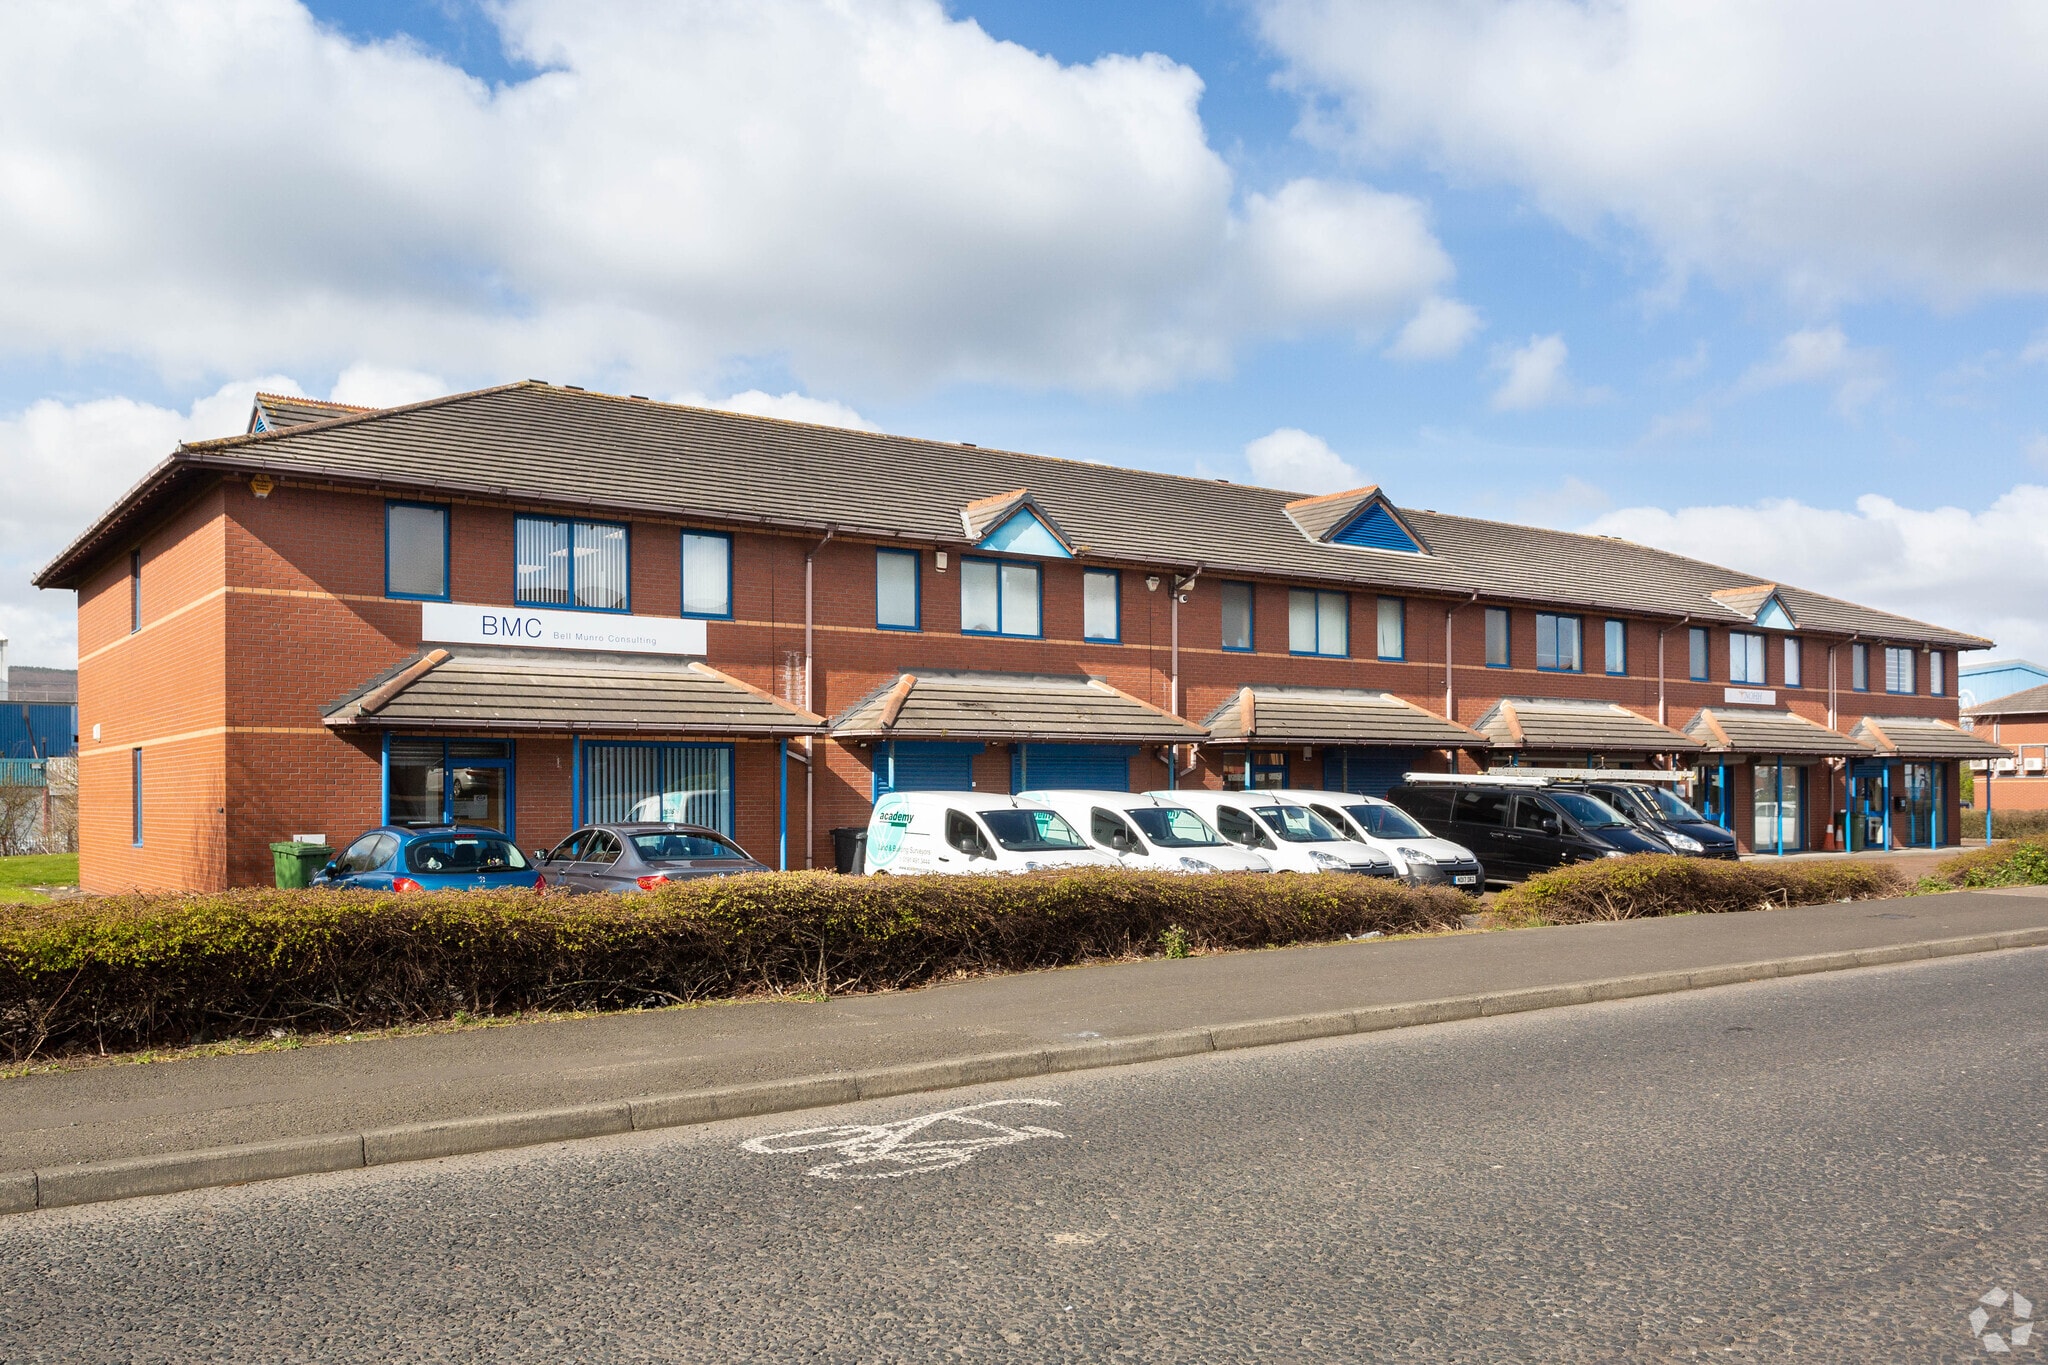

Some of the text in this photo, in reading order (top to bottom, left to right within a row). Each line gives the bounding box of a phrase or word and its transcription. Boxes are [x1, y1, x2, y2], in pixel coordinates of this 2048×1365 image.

[482, 615, 542, 639] BMC
[553, 631, 657, 646] Bell Munro Consulting
[879, 811, 914, 824] academy
